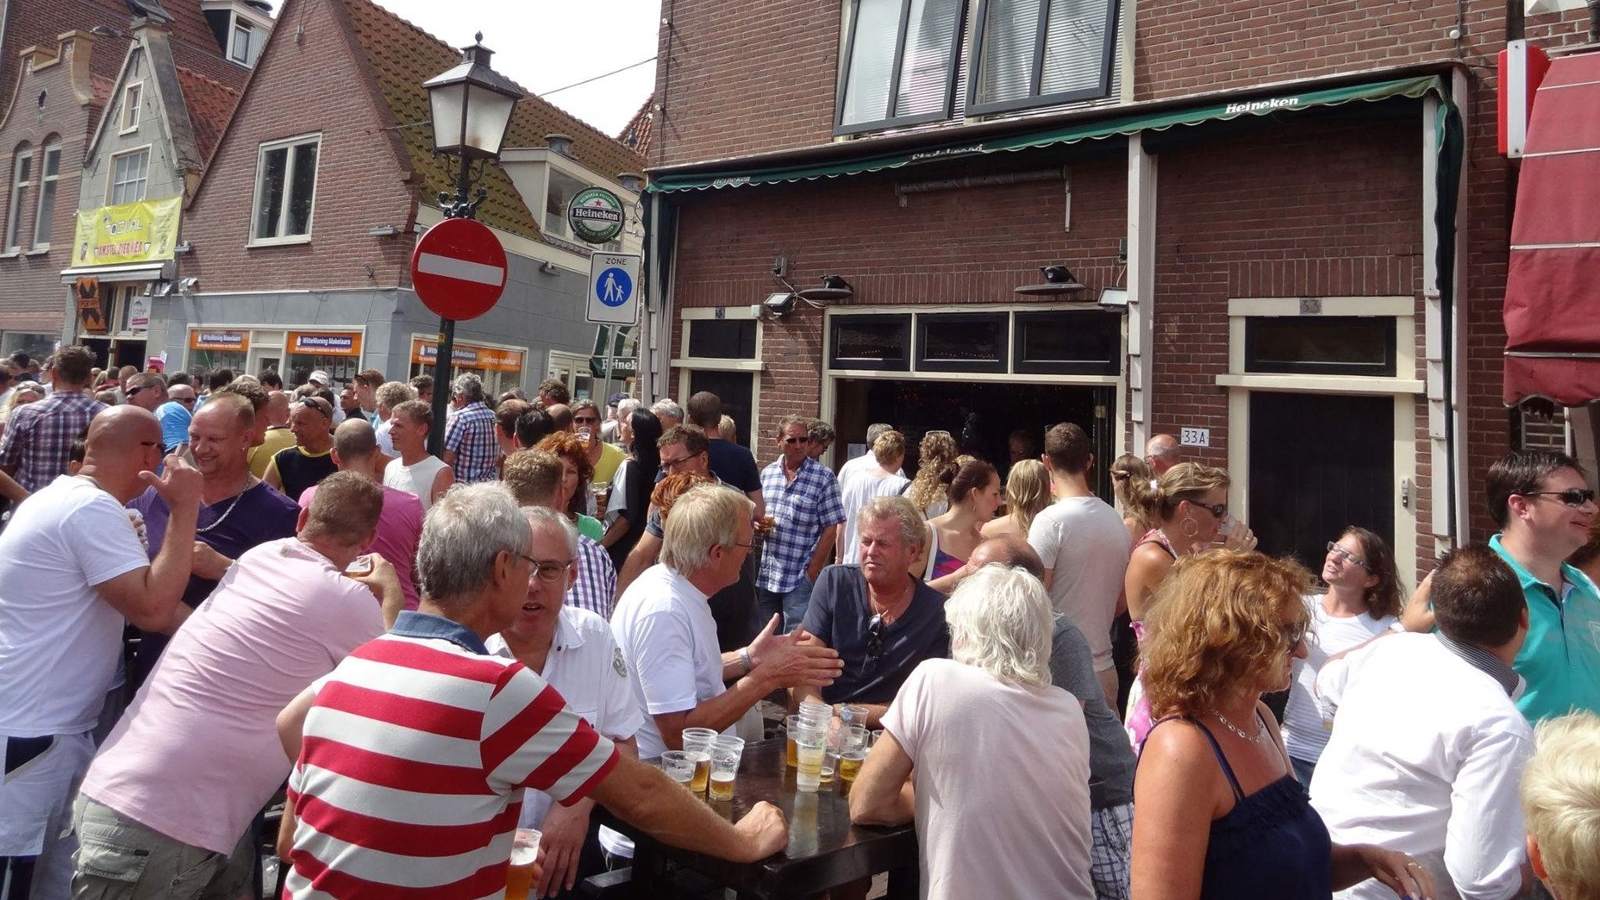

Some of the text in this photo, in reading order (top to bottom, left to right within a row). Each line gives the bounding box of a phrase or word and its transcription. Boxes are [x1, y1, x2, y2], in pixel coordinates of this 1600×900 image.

[1225, 97, 1299, 114] Heineken
[575, 207, 619, 221] Heineken
[606, 257, 627, 265] ZONE
[602, 358, 637, 370] Hinek
[1184, 430, 1205, 444] 33A
